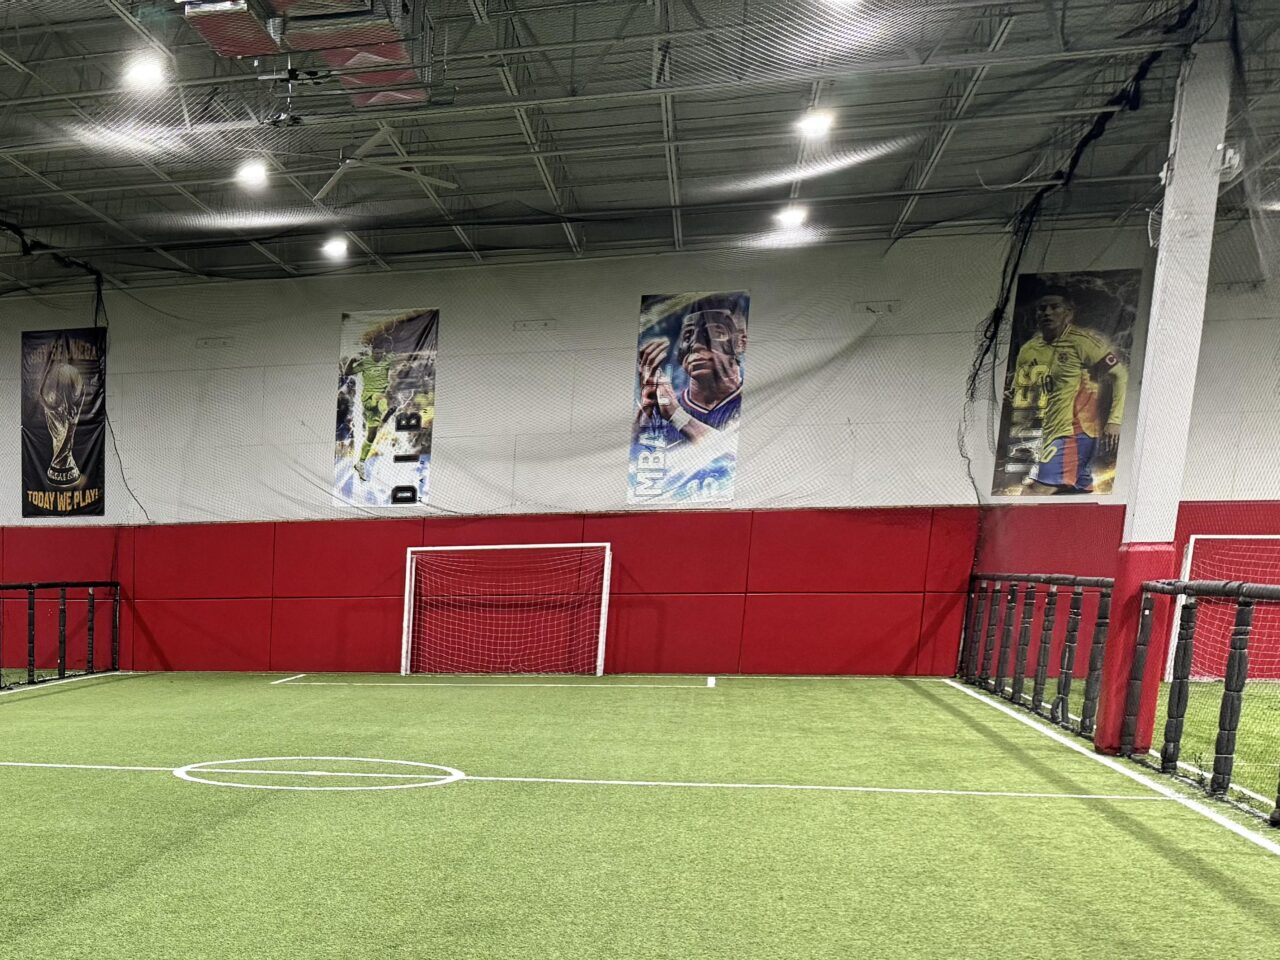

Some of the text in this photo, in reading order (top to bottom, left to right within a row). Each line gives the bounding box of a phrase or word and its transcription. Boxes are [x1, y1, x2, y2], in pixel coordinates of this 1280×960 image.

[27, 488, 99, 513] TODAY WE PLAY!
